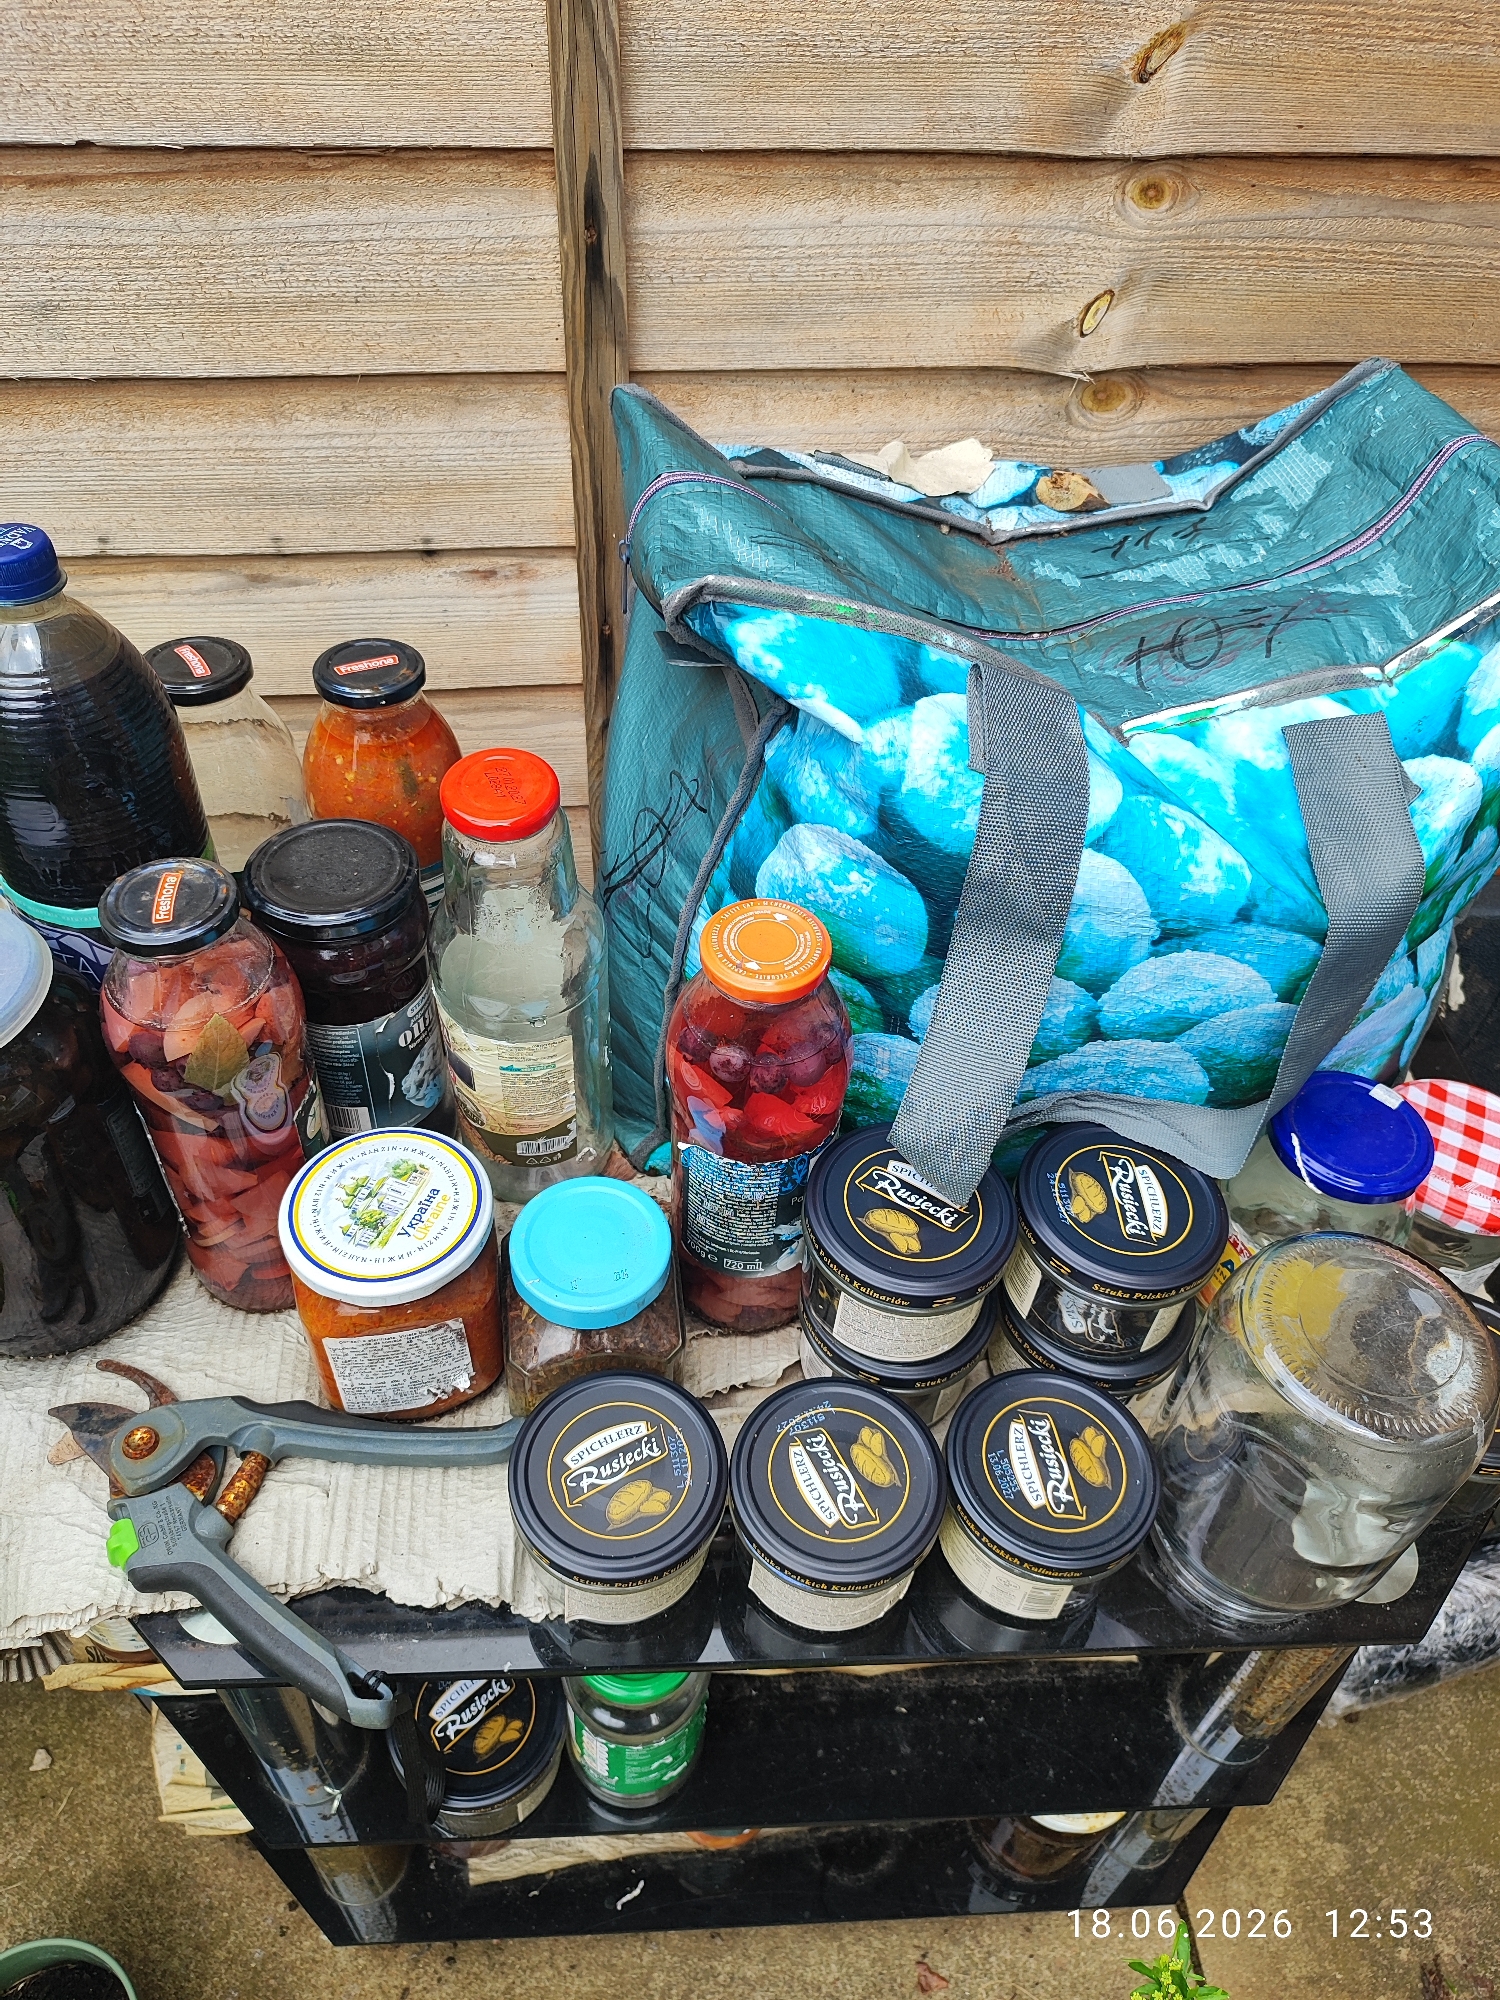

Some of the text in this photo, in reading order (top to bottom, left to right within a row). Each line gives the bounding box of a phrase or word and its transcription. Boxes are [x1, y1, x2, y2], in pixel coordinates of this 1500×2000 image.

[179, 647, 206, 675] Freshona
[340, 656, 395, 674] Freshona
[155, 875, 178, 921] Freshona
[720, 906, 741, 920] SAFETY
[742, 901, 755, 909] CAP
[396, 1188, 440, 1238] Україна
[412, 1194, 452, 1241] Ukraine
[872, 1170, 959, 1228] Rusiecki
[1108, 1157, 1150, 1236] Rusiecki
[1138, 1168, 1163, 1231] SPICHLERZ
[687, 1239, 706, 1258] 700g
[726, 1260, 760, 1271] 720 ml
[820, 1249, 851, 1283] Polskich
[852, 1279, 911, 1306] Kulinariów
[1091, 1283, 1131, 1299] Sztuka
[1132, 1289, 1177, 1301] Polskich
[1022, 1342, 1057, 1371] Polskich
[914, 1376, 948, 1389] Sztuka
[566, 1436, 662, 1493] Rusiecki
[570, 1424, 644, 1466] SPICHLERZ
[667, 1435, 682, 1477] 511307
[1013, 1427, 1043, 1502] SPICHLERZ
[1027, 1418, 1075, 1514] Rusiecki
[792, 1449, 836, 1520] SPICHLERZ
[805, 1433, 865, 1524] Rusiecki
[987, 1452, 1016, 1500] 13.06.2027
[174, 1506, 188, 1532] GERMANY
[956, 1503, 1084, 1578] Sztuka Polskich Kulinariów
[572, 1575, 611, 1588] Sztuka
[614, 1575, 660, 1588] Polskich
[783, 1568, 829, 1590] Polskich
[830, 1576, 893, 1592] Kulinariów
[435, 1679, 511, 1741] Rusiecki
